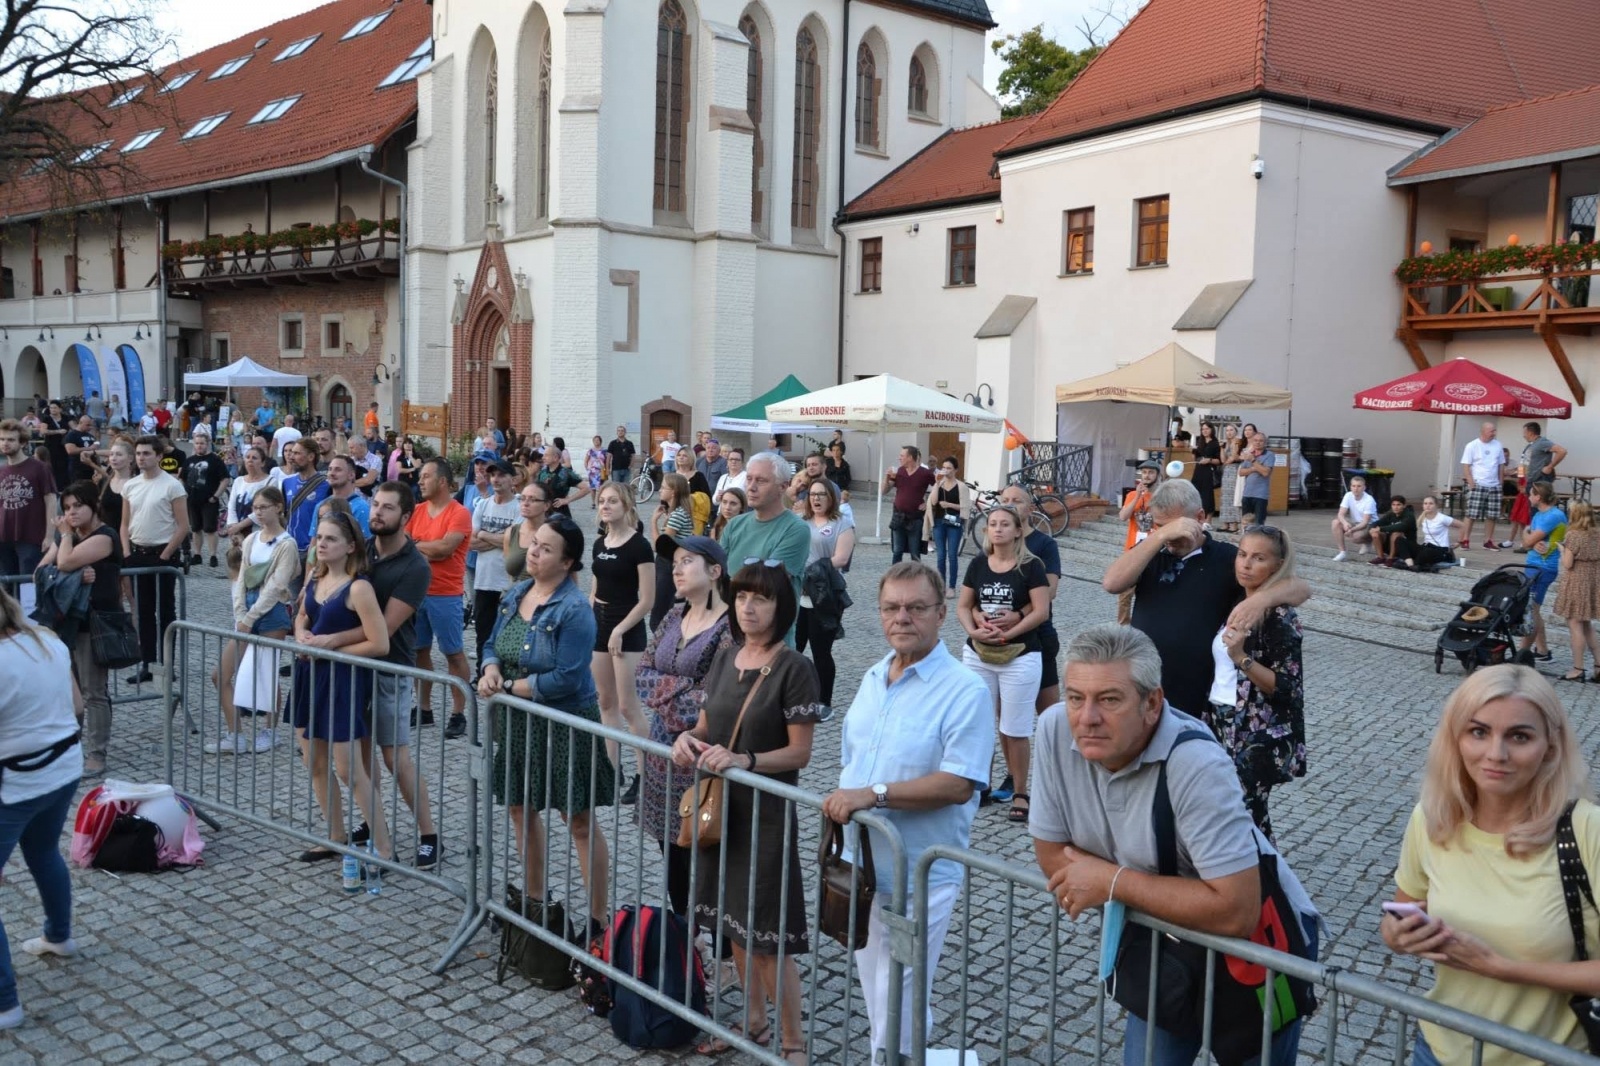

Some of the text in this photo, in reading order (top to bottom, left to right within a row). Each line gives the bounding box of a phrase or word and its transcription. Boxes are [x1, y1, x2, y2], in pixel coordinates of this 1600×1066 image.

[1361, 397, 1414, 408] RACIBORSKIE
[1430, 399, 1504, 413] RACIBORSKIE
[800, 406, 846, 416] RACIBORSKIE
[1519, 403, 1567, 416] RACIBORSKIE
[925, 410, 971, 424] RACIBORSKIE
[994, 588, 1009, 596] LAT
